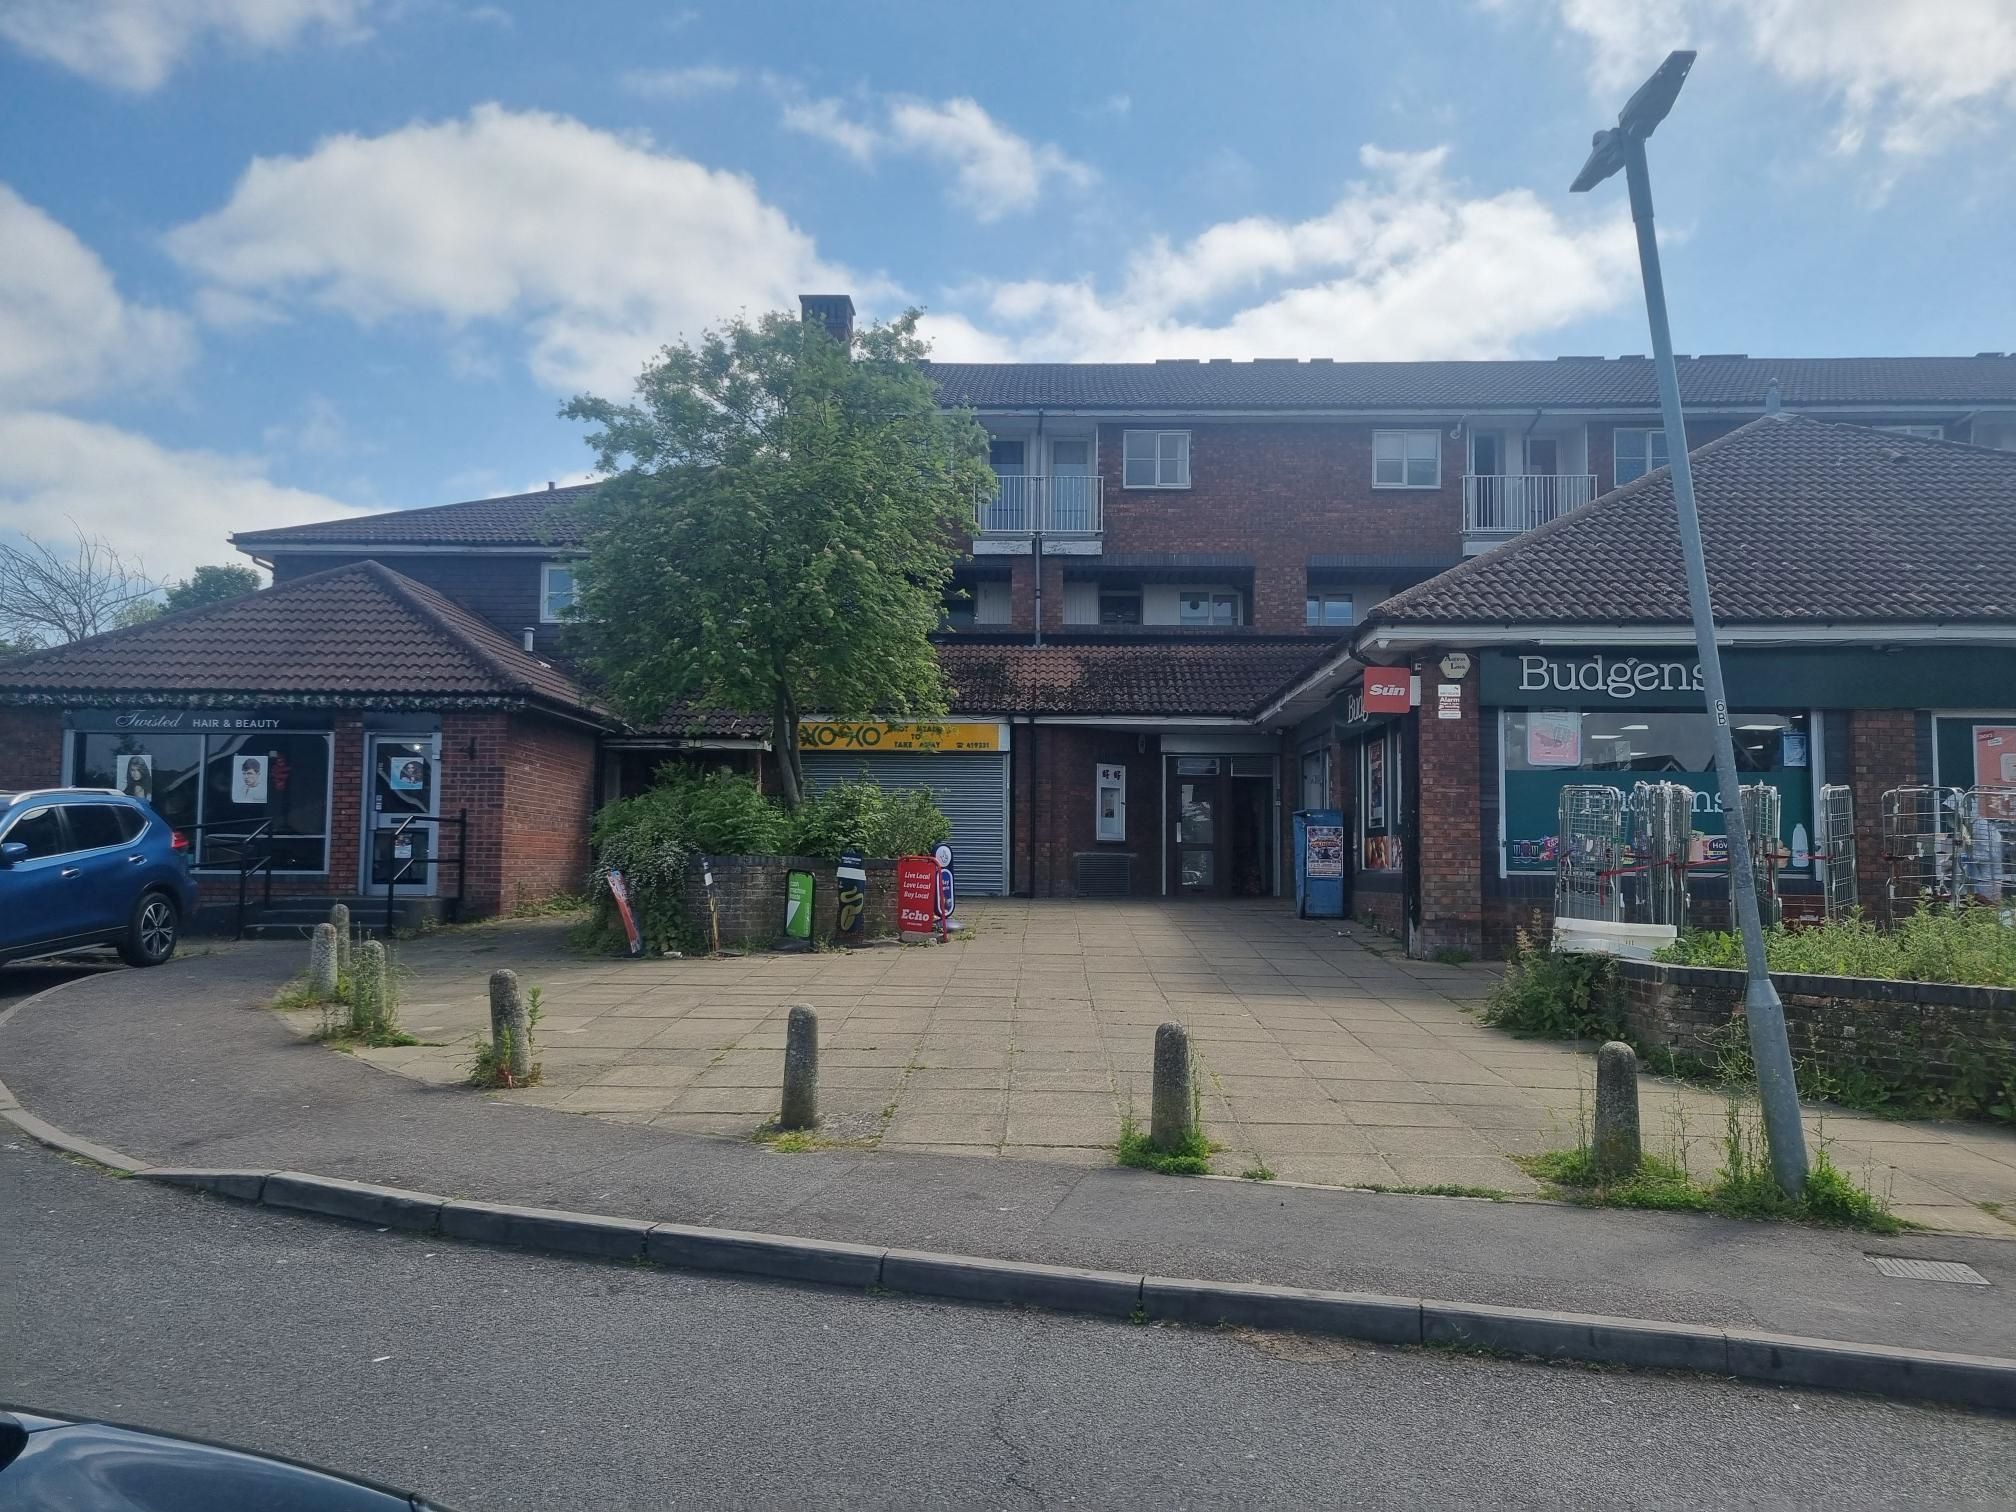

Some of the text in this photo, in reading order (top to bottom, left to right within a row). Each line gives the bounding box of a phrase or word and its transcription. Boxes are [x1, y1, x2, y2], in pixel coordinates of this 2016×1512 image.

[1369, 684, 1406, 696] Sun
[1716, 700, 1725, 711] 6
[115, 709, 280, 728] Twisted HAIR & BEAUTY
[1718, 713, 1726, 724] B
[904, 871, 931, 880] Live Local
[903, 890, 930, 899] Buy Local
[901, 908, 930, 921] Echo
